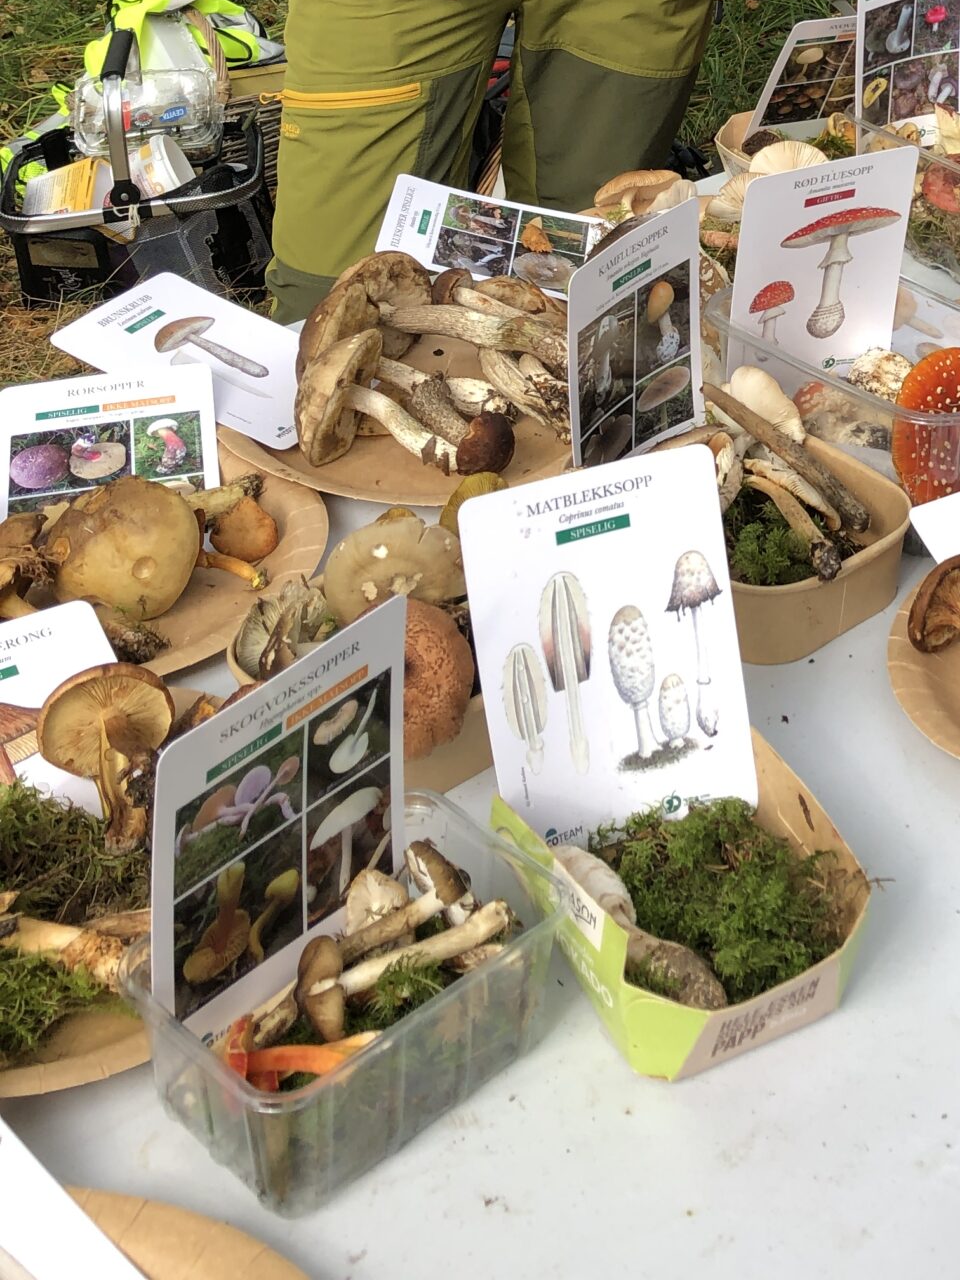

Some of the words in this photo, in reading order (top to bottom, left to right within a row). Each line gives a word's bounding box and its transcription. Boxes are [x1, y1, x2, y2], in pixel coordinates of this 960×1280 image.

[793, 177, 818, 190] RØD
[820, 165, 874, 184] FLUESOPP
[816, 194, 843, 204] GIFTIG
[598, 226, 669, 277] KAMFLUESOPPER
[97, 294, 153, 328] BRUNSKRUBB
[47, 407, 88, 419] SPISELIG
[525, 474, 653, 518] MATBLEKKSOPP
[558, 508, 593, 525] Coprinus
[594, 500, 625, 516] comatus
[570, 519, 616, 541] SPISELIG
[218, 640, 361, 745] SKOGVOKSSOPPER
[546, 825, 584, 847] COTEAM
[711, 1021, 766, 1058] PAPP
